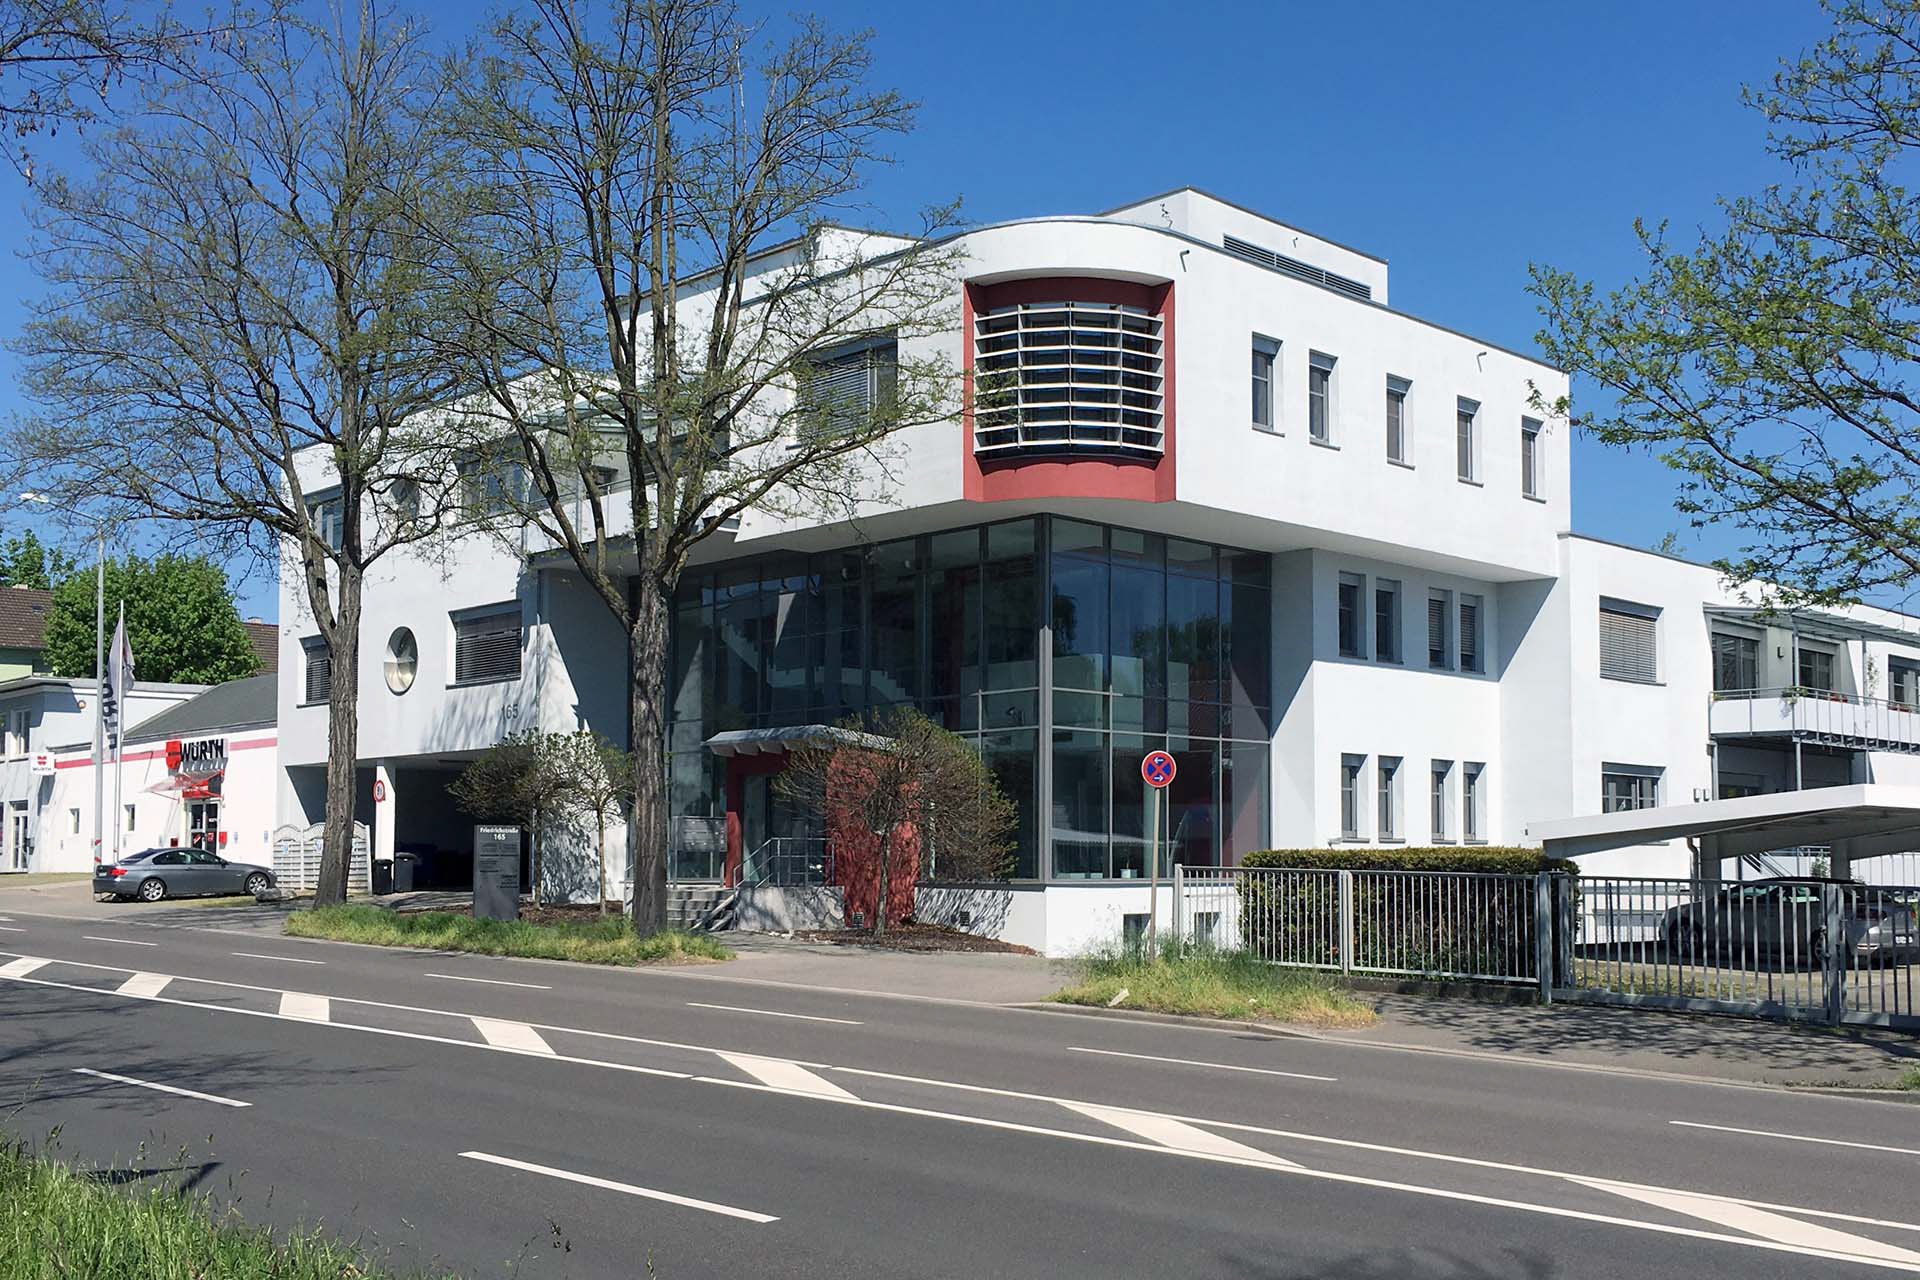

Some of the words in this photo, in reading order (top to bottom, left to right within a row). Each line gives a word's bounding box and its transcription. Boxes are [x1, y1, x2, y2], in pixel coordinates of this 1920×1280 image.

[501, 704, 519, 719] 165
[180, 738, 225, 762] WÜRTH
[493, 833, 506, 841] 165
